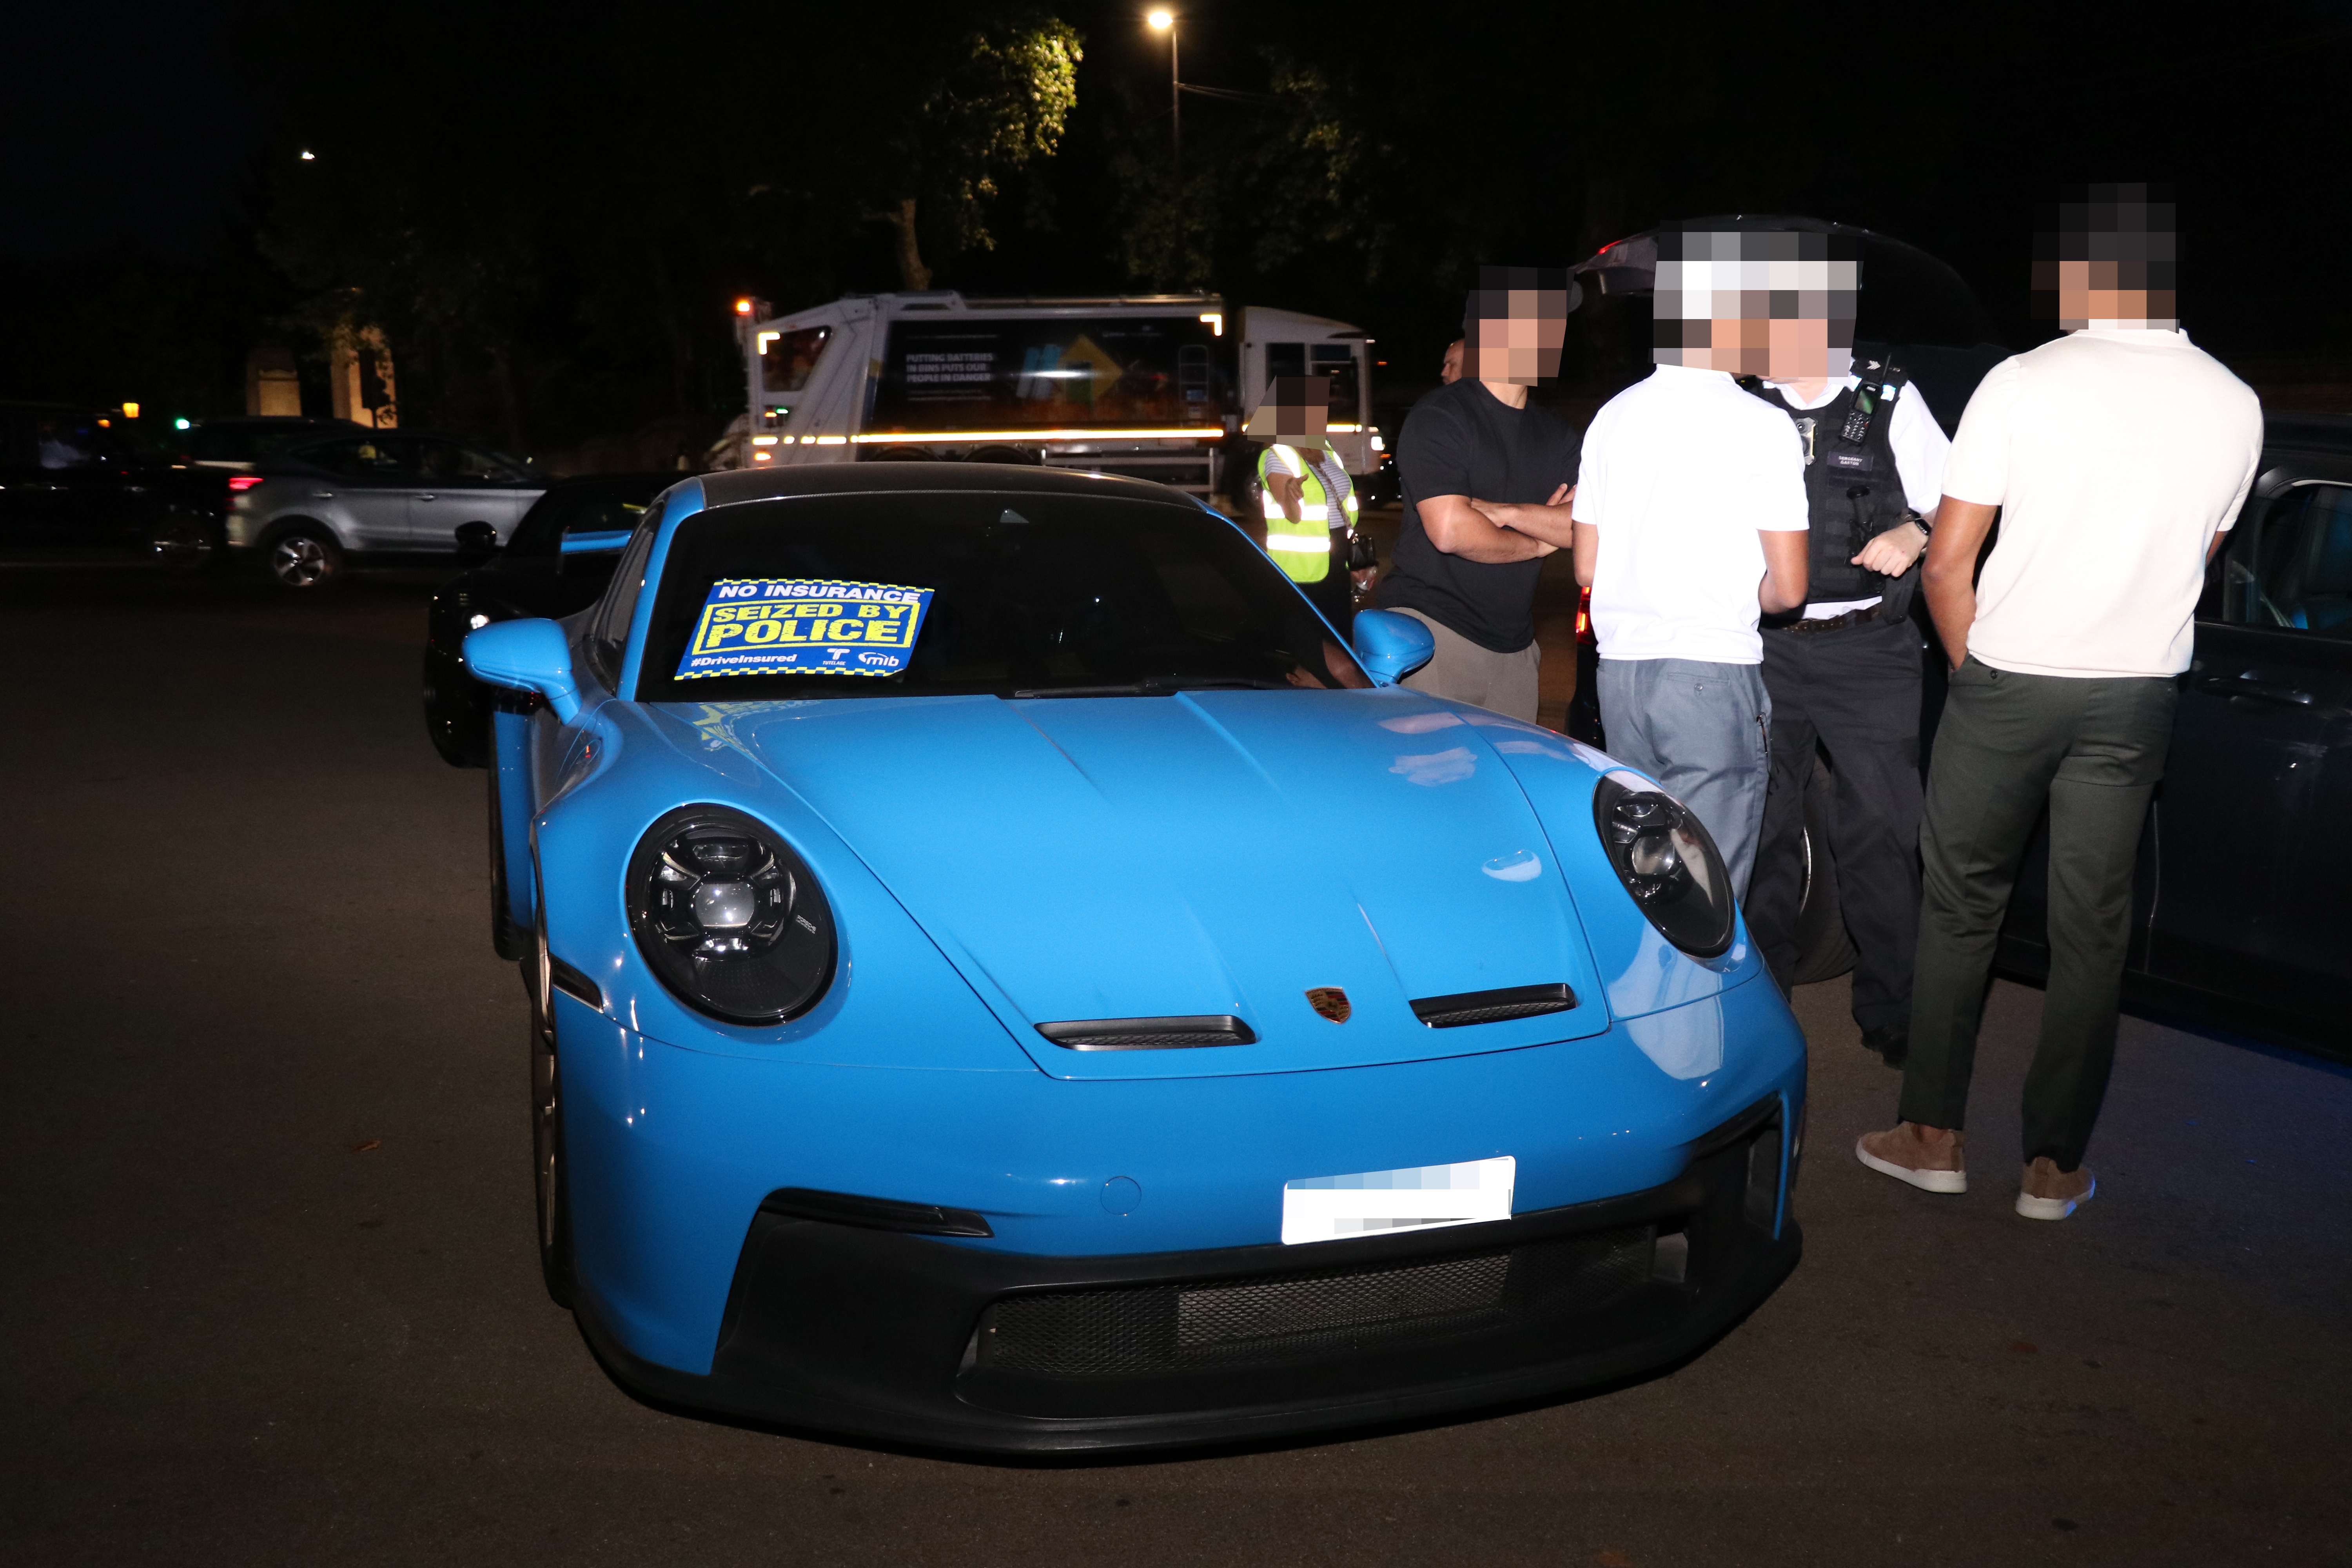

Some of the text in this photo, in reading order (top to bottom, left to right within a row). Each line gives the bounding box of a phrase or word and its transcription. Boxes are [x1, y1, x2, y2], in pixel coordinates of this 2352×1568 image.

[906, 353, 993, 362] PUTTING BATTERIES
[906, 363, 986, 372] IN BINS PUTS OUR
[906, 373, 939, 382] PEOPLE
[953, 373, 990, 381] DANGER
[719, 585, 920, 603] NO INSURANCE
[713, 604, 910, 622] SEIZED BY
[706, 619, 901, 648] POLICE
[691, 654, 797, 666] #DriveInsured
[866, 655, 899, 666] mib
